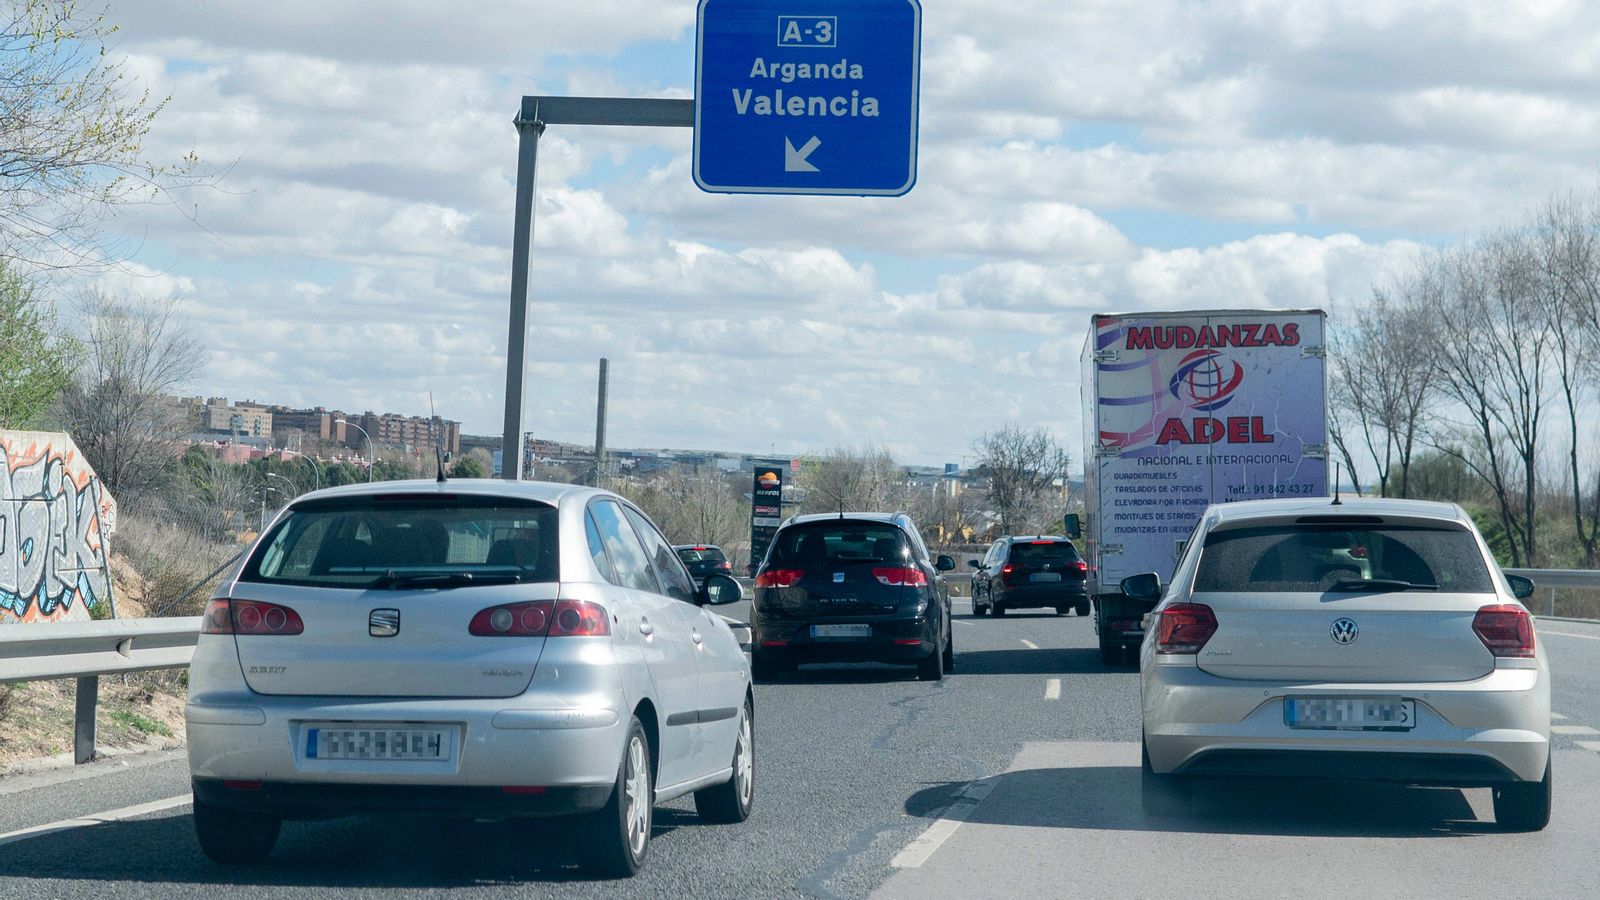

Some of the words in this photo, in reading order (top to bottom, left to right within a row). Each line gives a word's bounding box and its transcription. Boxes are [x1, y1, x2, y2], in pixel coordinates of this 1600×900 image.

[782, 20, 832, 43] A-3
[750, 57, 864, 83] Arganda
[732, 88, 880, 117] Valencia
[1126, 323, 1300, 350] MUDANZAS
[1155, 416, 1275, 445] ADEL
[1137, 455, 1193, 466] NACIONAL
[1196, 455, 1203, 465] E
[1206, 454, 1294, 465] INTERNACIONAL
[1114, 485, 1157, 493] TRASLADOS
[1158, 485, 1168, 493] DE
[1254, 484, 1265, 494] 91
[1268, 484, 1286, 494] 842
[1288, 484, 1300, 494] 43
[1302, 483, 1314, 494] 27
[1155, 512, 1165, 520] DE
[1114, 526, 1157, 534] MUDANZAS
[1158, 526, 1168, 534] EN
